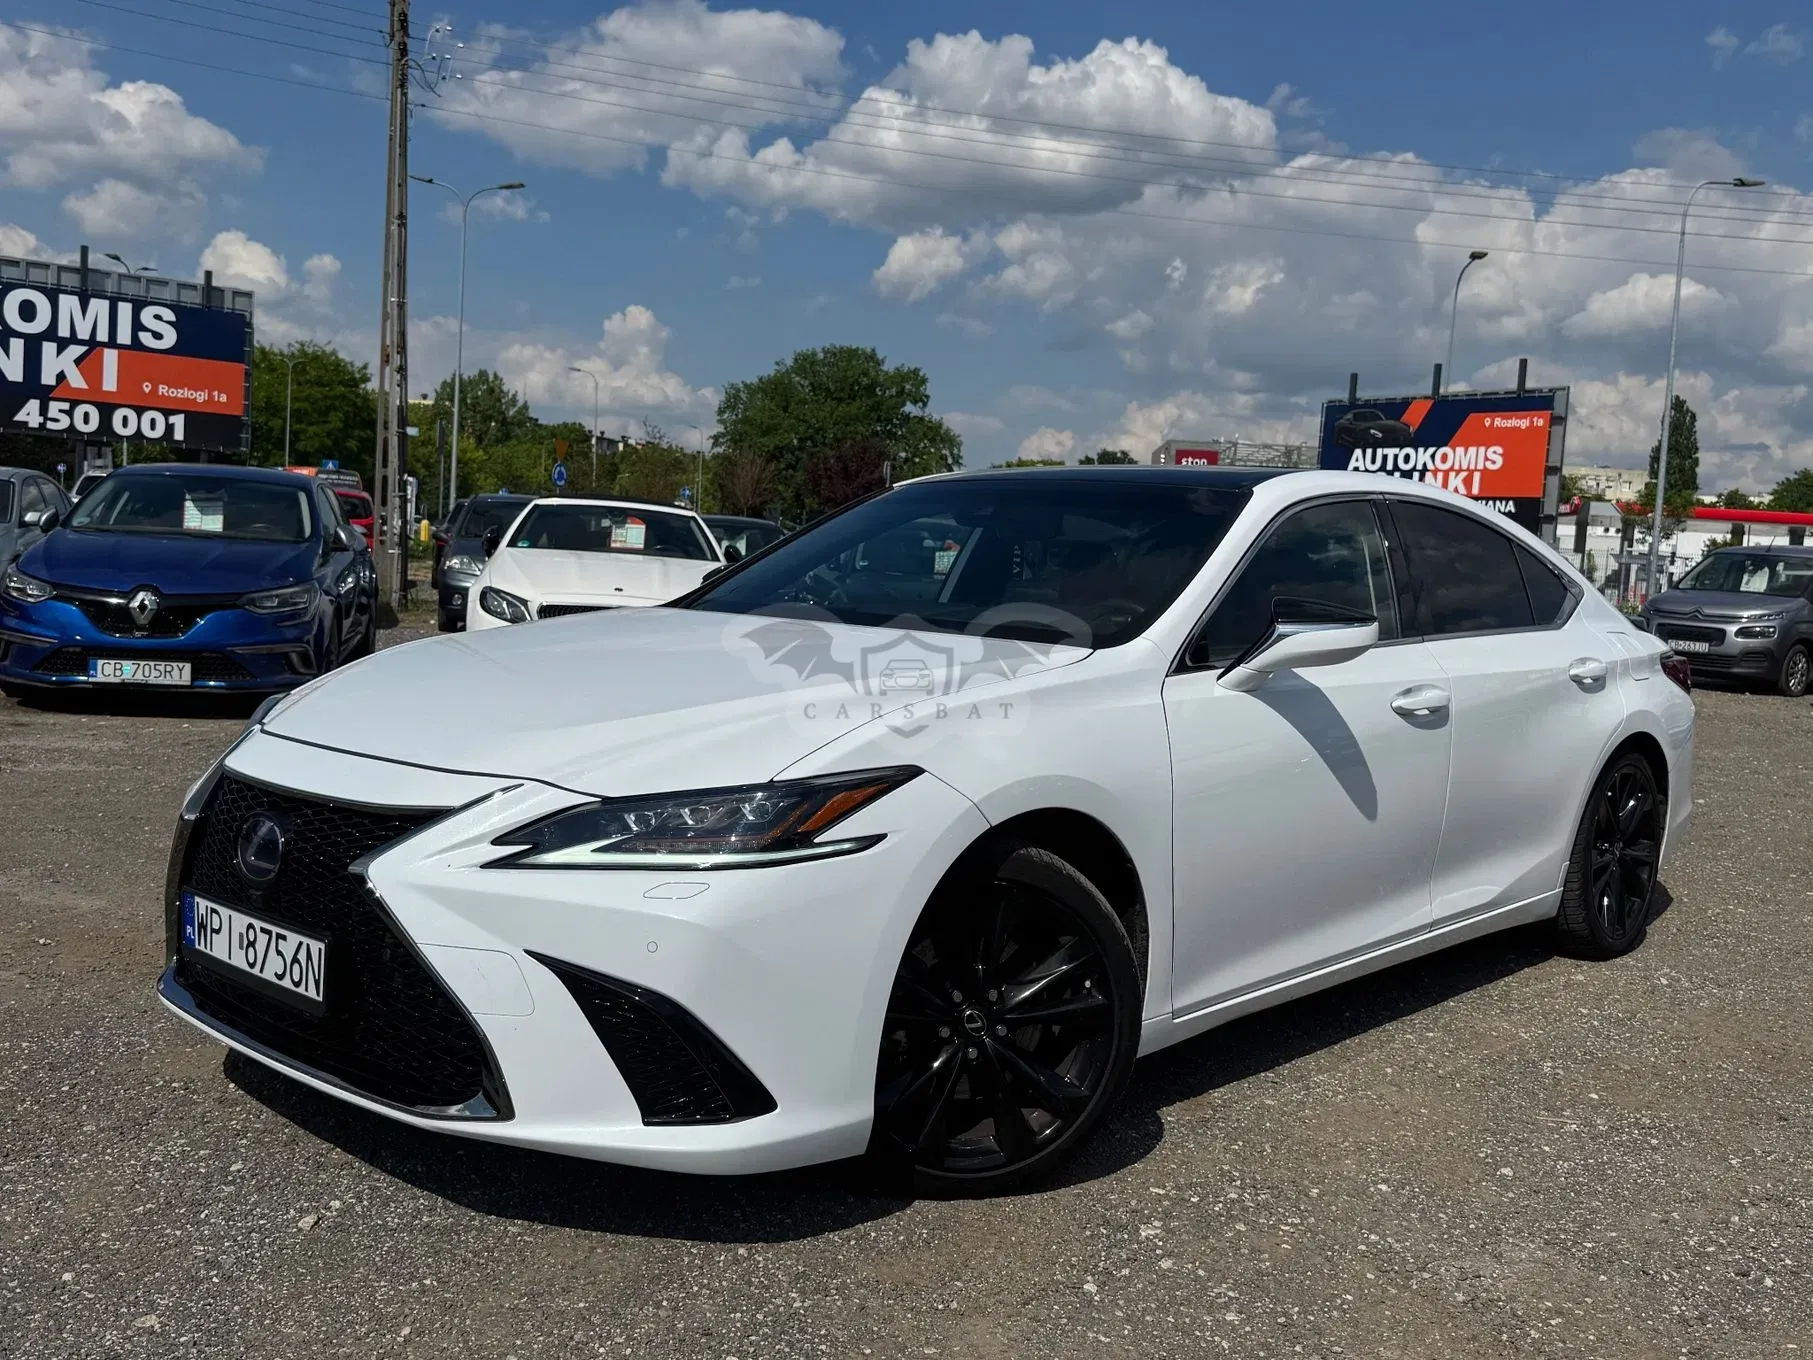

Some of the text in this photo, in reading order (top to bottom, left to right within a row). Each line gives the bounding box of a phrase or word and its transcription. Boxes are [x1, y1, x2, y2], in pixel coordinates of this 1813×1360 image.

[0, 287, 178, 350] OMIS
[212, 389, 227, 403] 1a
[12, 398, 186, 441] 450 001
[1532, 416, 1544, 427] 1a
[1347, 446, 1504, 472] AUTOKOMIS
[101, 662, 186, 680] CB 705RY
[186, 925, 195, 939] PL
[196, 901, 323, 998] WPI 8756N
